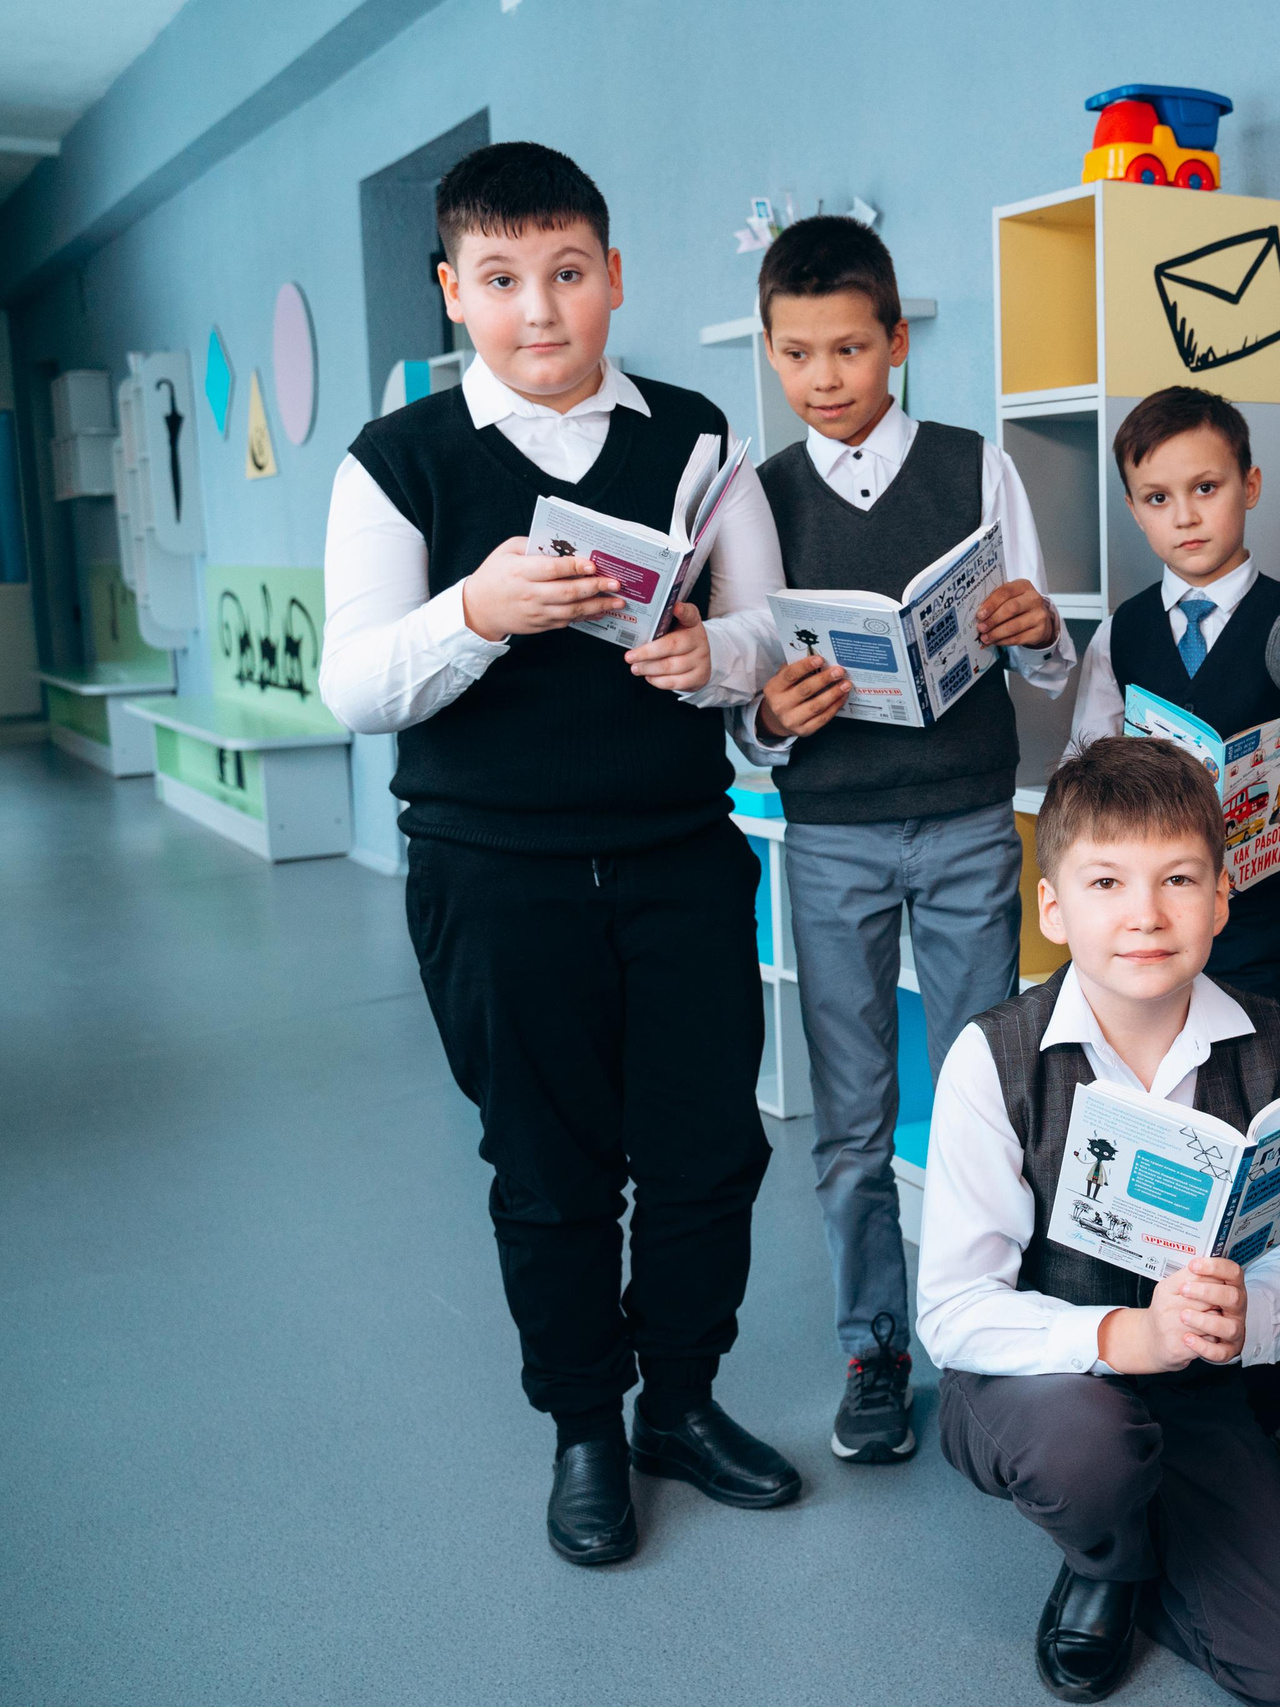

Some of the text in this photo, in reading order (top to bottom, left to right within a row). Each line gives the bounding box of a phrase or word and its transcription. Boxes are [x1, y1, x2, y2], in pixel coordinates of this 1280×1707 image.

[920, 555, 983, 621] НАУЧНЫЕ
[944, 552, 998, 609] ФОКУСЫ
[1233, 844, 1250, 866] КАК
[1145, 1236, 1194, 1253] APPROVED
